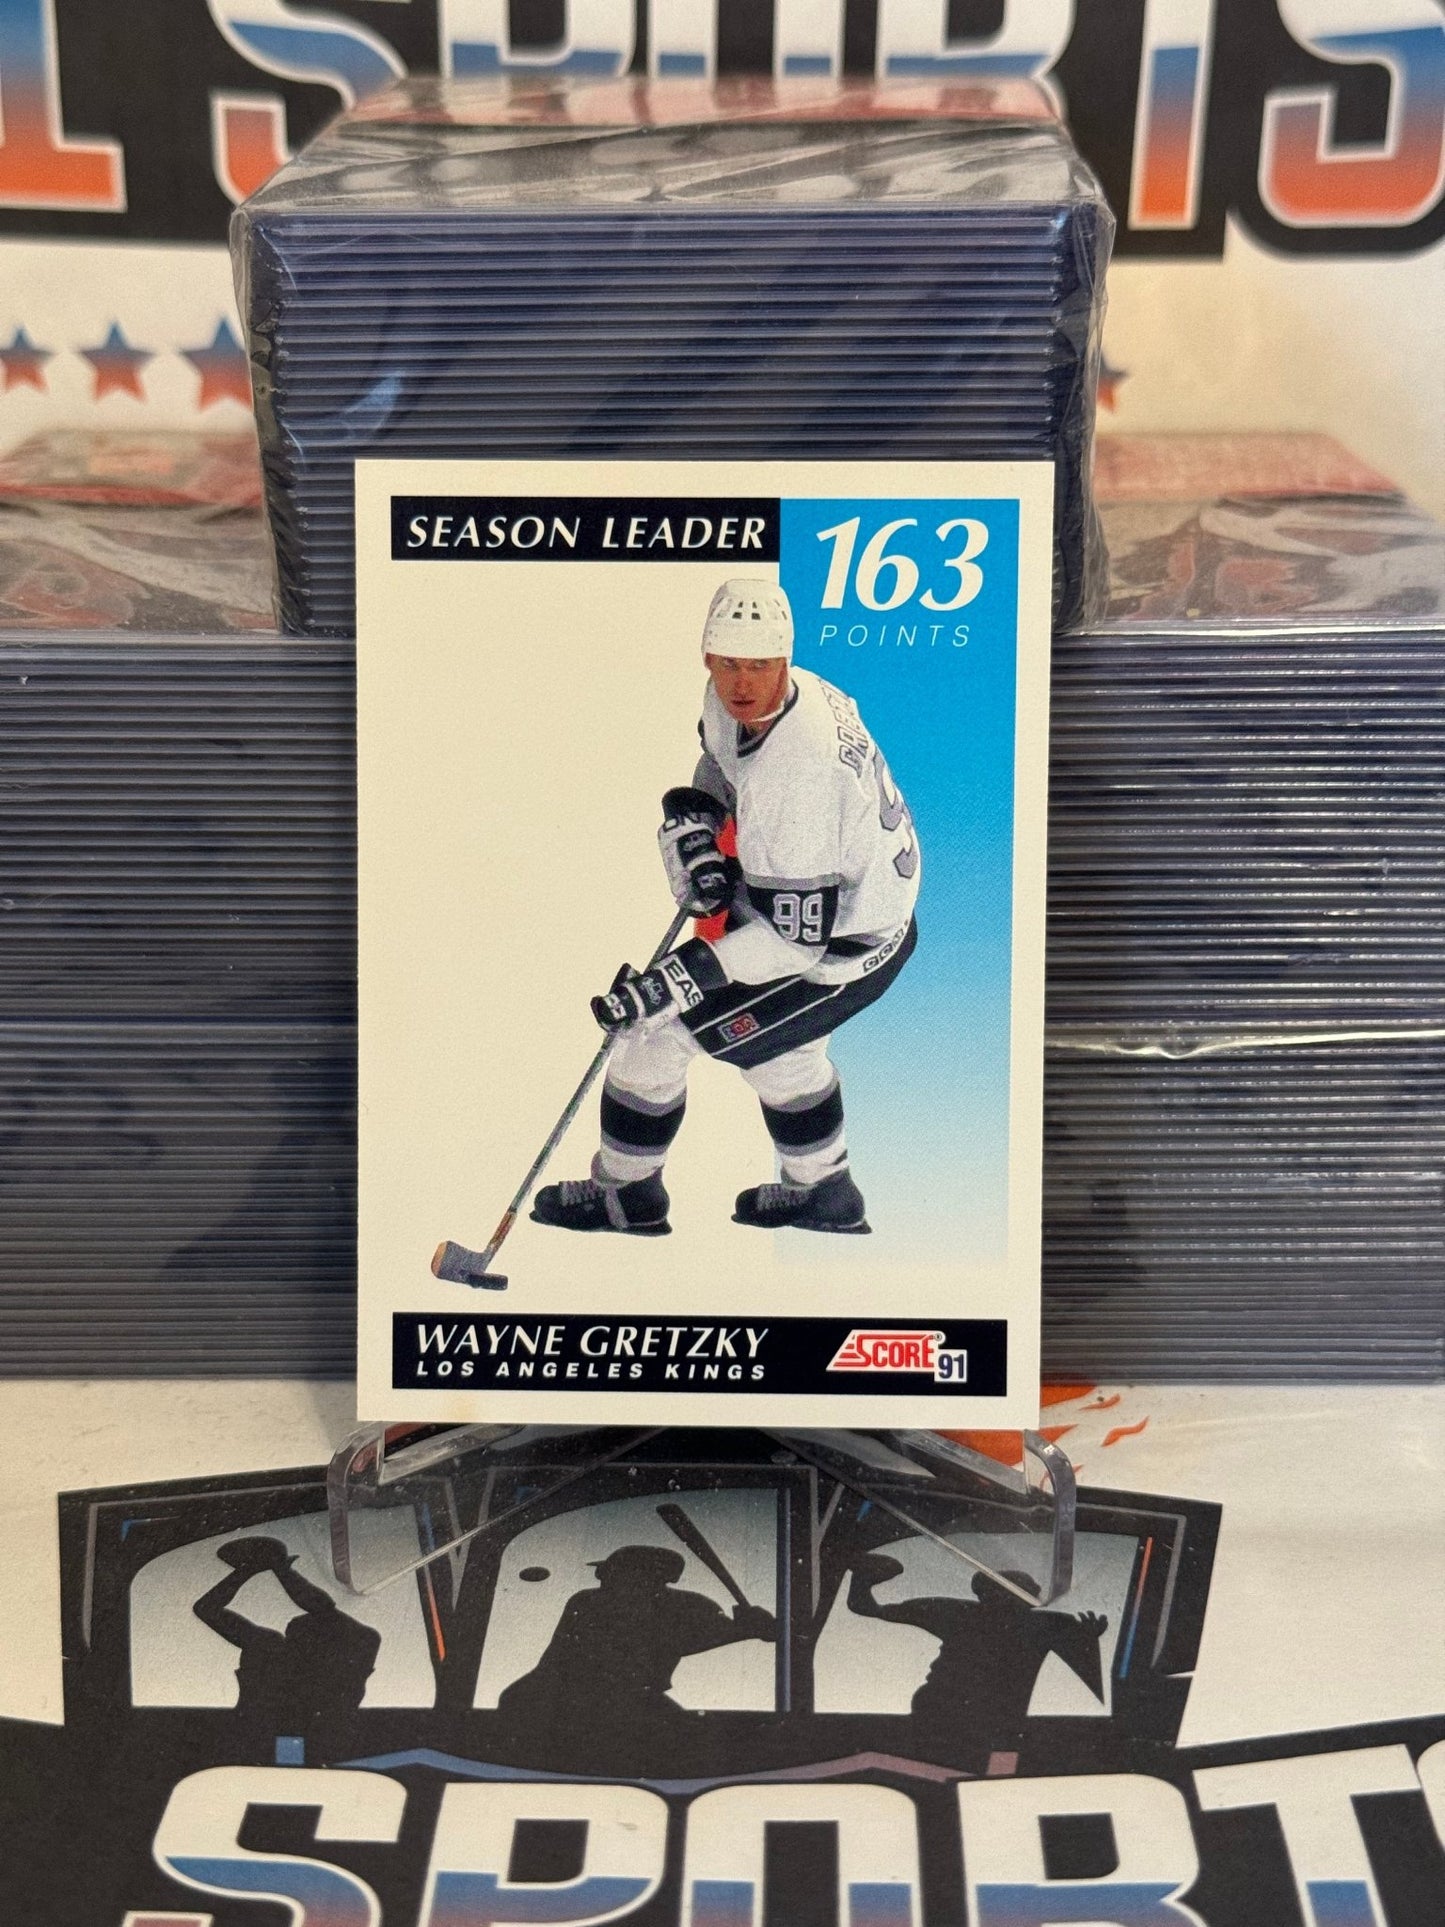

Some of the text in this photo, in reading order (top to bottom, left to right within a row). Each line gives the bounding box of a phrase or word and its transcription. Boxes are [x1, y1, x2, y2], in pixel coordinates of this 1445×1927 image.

[406, 515, 765, 549] SEASON LEADER
[816, 516, 989, 612] 163
[819, 624, 970, 647] POINTS
[773, 893, 823, 942] 99
[417, 1324, 769, 1359] WAYNE GRETZKY
[832, 1333, 936, 1369] SCORE
[416, 1361, 766, 1381] LOS ANGELES KINGS
[937, 1353, 965, 1380] 91
[122, 1738, 1445, 1927] SPORT
